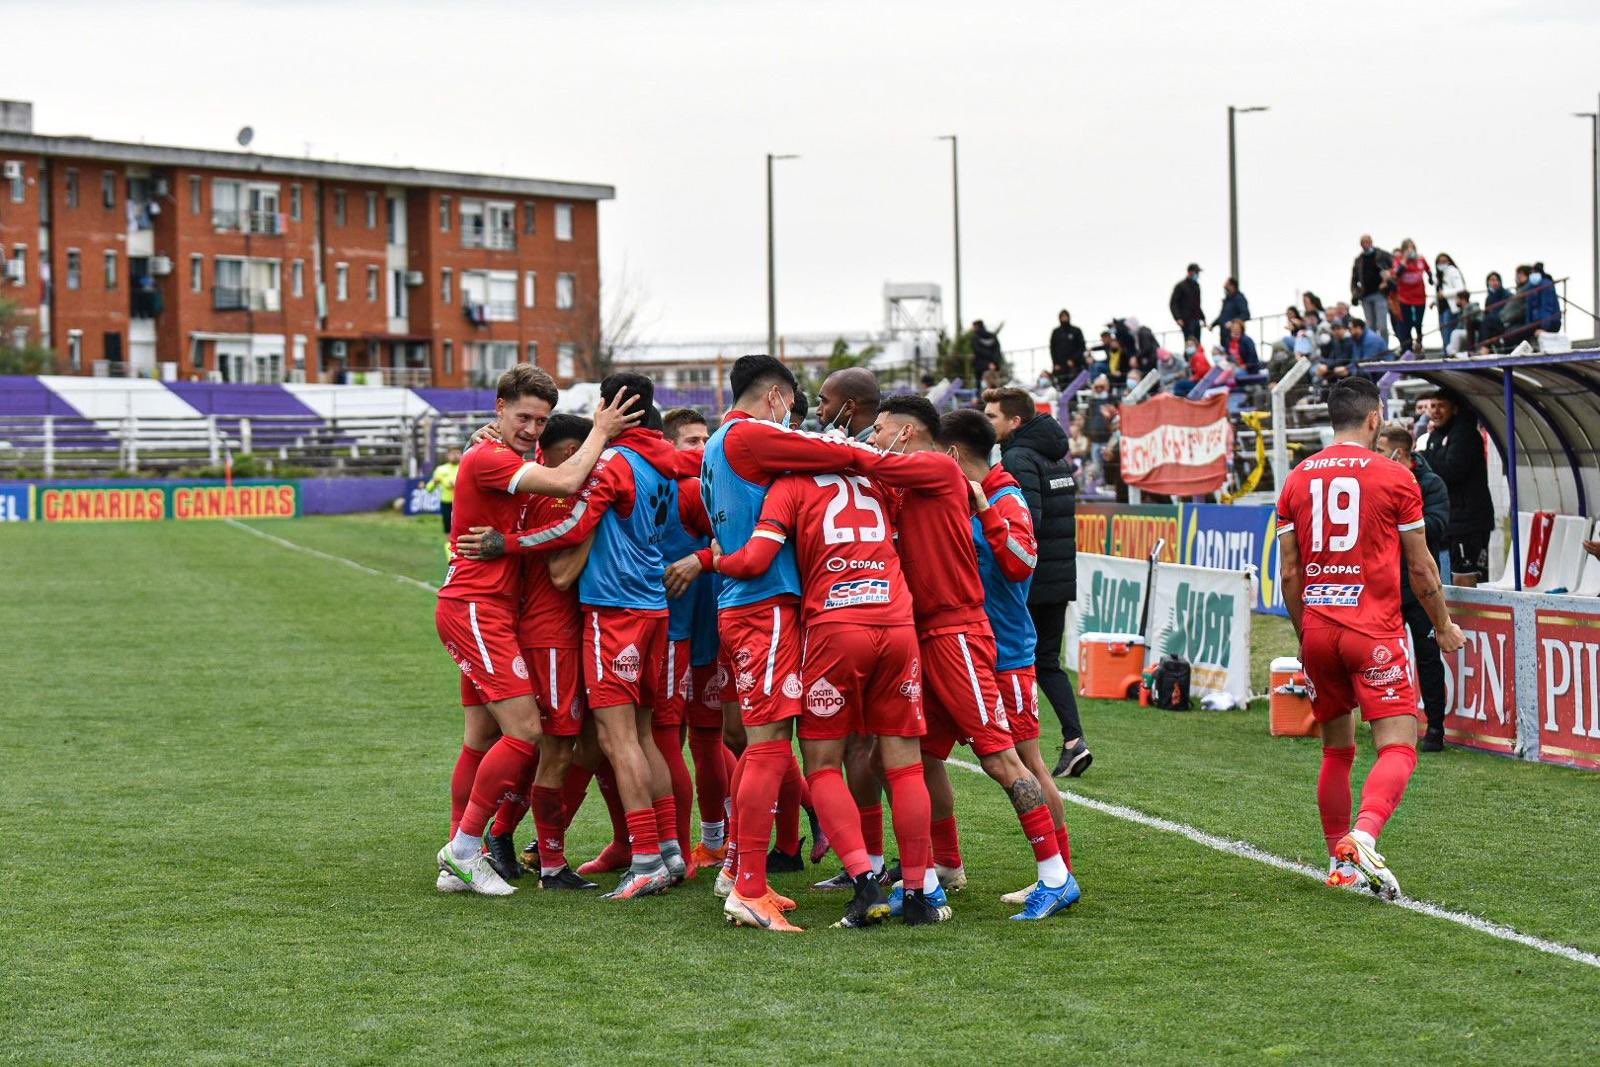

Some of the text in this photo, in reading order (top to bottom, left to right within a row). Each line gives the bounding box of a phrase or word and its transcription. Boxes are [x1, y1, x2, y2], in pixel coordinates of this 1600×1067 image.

[1303, 458, 1372, 471] DIRECTV
[43, 490, 165, 521] CANARIAS
[174, 486, 296, 518] CANARIAS
[813, 473, 886, 545] 25
[1309, 476, 1361, 552] 19
[849, 560, 885, 571] COPAC
[1322, 565, 1361, 574] COPAC
[1078, 570, 1142, 635] SUAT
[1162, 582, 1235, 669] SUAT
[807, 694, 844, 710] limpa
